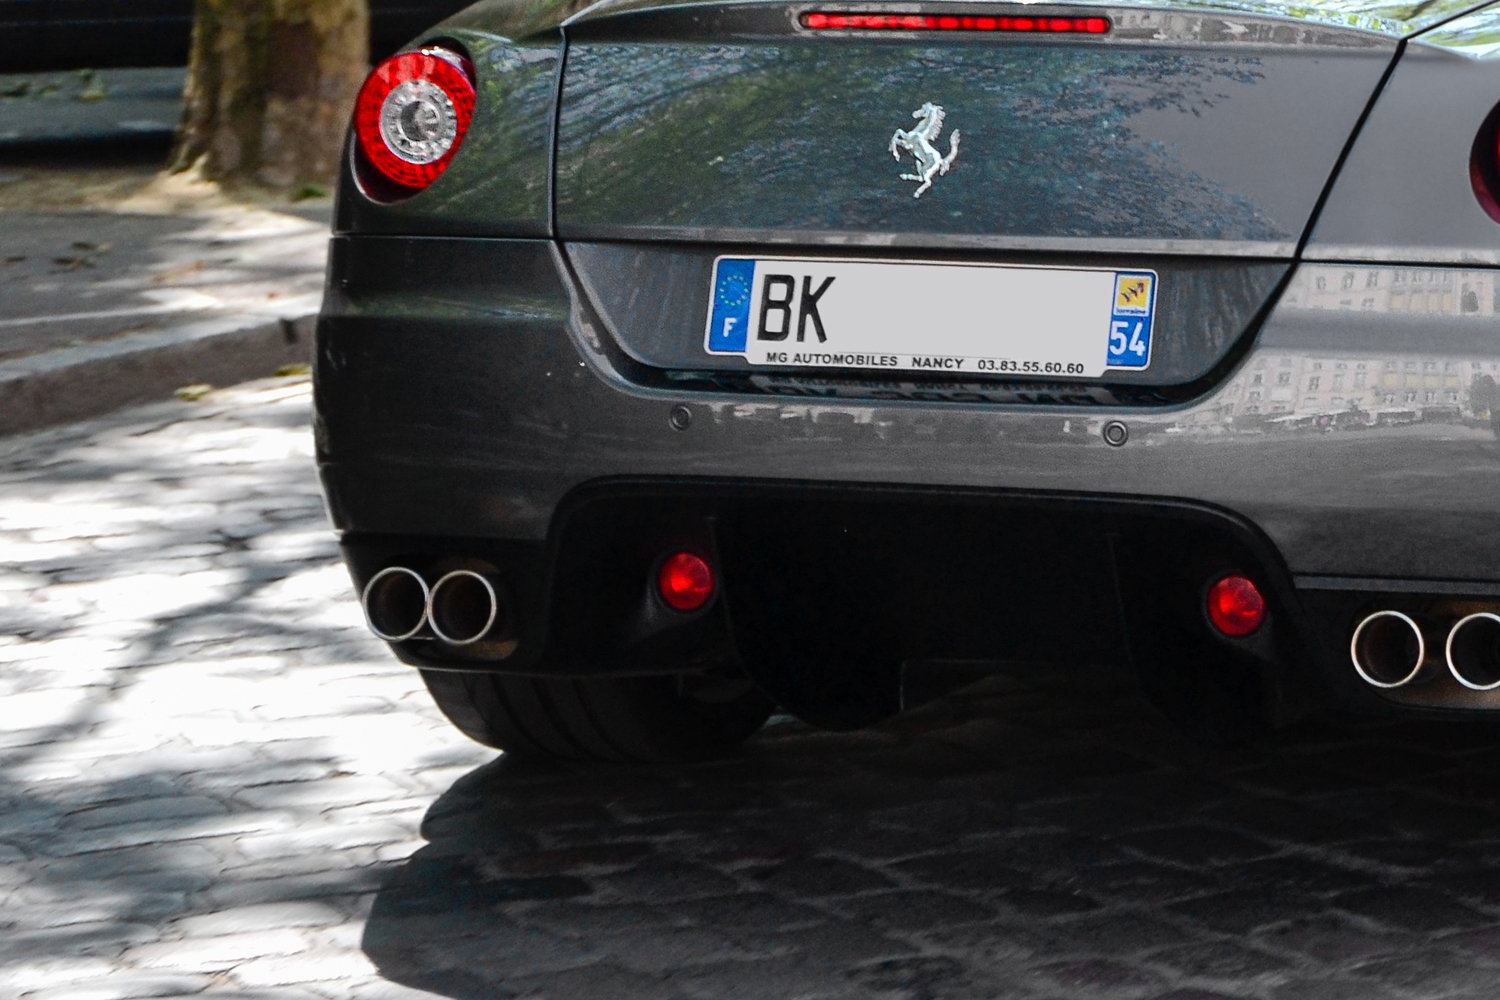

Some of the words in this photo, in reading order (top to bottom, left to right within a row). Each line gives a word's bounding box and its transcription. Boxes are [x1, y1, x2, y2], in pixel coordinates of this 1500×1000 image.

[756, 273, 836, 343] BK
[722, 318, 736, 337] F
[1109, 320, 1146, 357] 54
[766, 352, 788, 363] MG
[794, 353, 898, 367] AUTOMOBILES
[912, 357, 964, 370] NANCY
[978, 359, 1085, 374] 03.83.55.60.60
